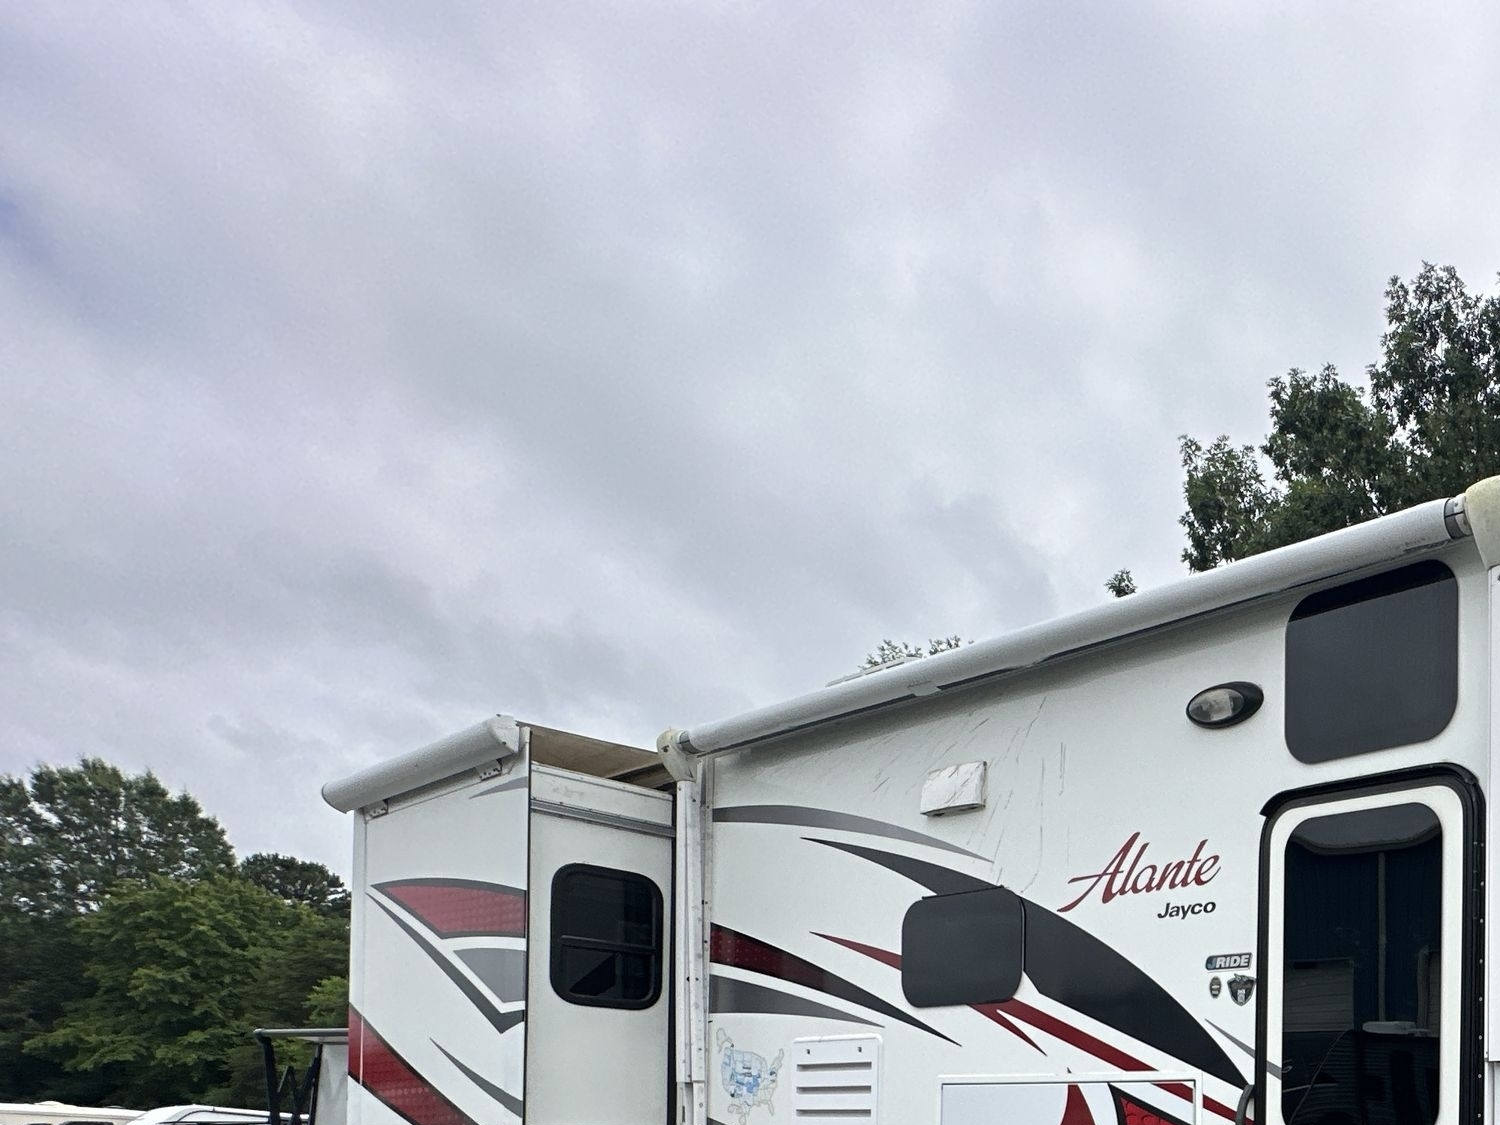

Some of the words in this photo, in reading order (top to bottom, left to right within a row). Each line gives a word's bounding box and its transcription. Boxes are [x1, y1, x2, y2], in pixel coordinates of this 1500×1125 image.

[1057, 832, 1221, 912] Alante
[1157, 901, 1216, 919] Jayco
[1206, 954, 1250, 969] JRIDE
